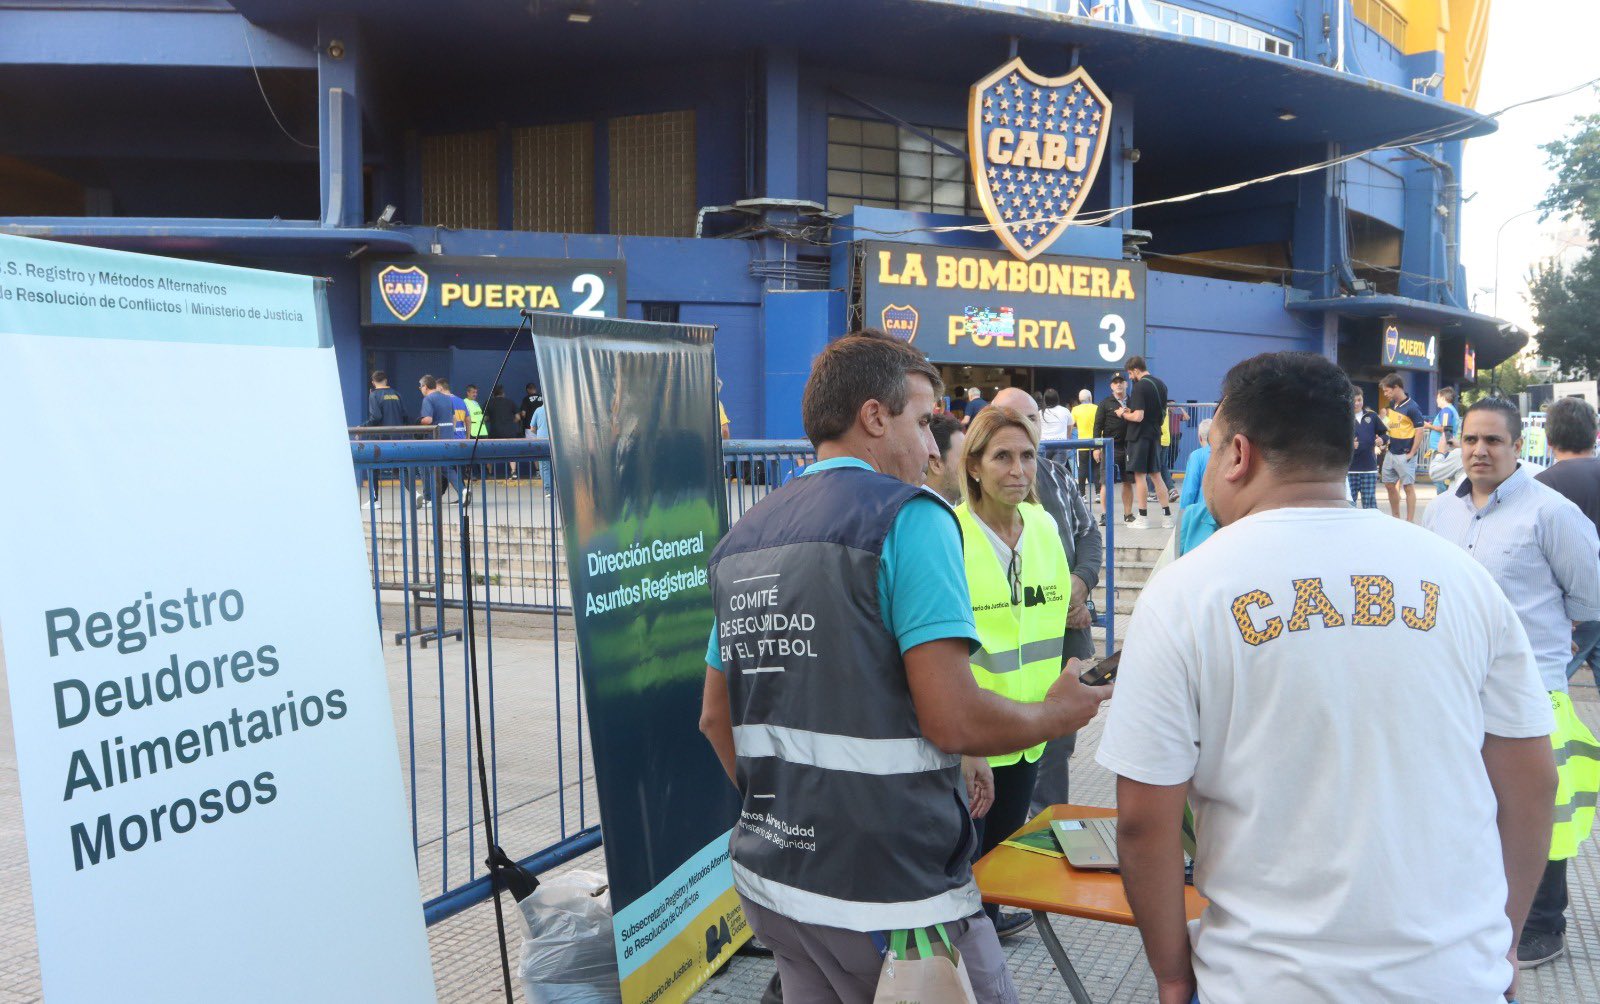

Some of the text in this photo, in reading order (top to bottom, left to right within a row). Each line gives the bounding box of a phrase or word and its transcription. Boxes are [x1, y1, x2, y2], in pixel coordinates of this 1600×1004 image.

[986, 127, 1091, 172] CABJ
[0, 261, 228, 296] .S. Registro y Métodos Alternativos
[385, 283, 422, 294] CABJ
[878, 250, 1135, 300] LA BOMBONERA
[16, 287, 97, 307] Resolución
[100, 294, 116, 308] de
[118, 296, 182, 313] Conflictos
[191, 302, 246, 318] Ministerio
[247, 306, 261, 319] de
[263, 308, 304, 322] Justicia
[441, 273, 606, 317] PUERTA 2
[886, 318, 914, 330] CABJ
[1098, 313, 1127, 362] 3
[1399, 335, 1436, 367] PUERTA 4
[587, 531, 704, 577] Dirección General
[585, 584, 641, 617] Asuntos
[730, 585, 779, 612] COMITÉ
[1230, 574, 1441, 646] CABJ
[44, 587, 245, 657] Registro
[720, 620, 731, 639] DE
[721, 645, 733, 662] EN
[735, 642, 755, 659] EL
[53, 644, 280, 729] Deudores
[63, 688, 348, 802] Alimentarios
[70, 771, 278, 872] Morosos
[781, 820, 815, 838] Ciudad
[772, 833, 816, 852] Seguridad
[624, 945, 633, 959] de
